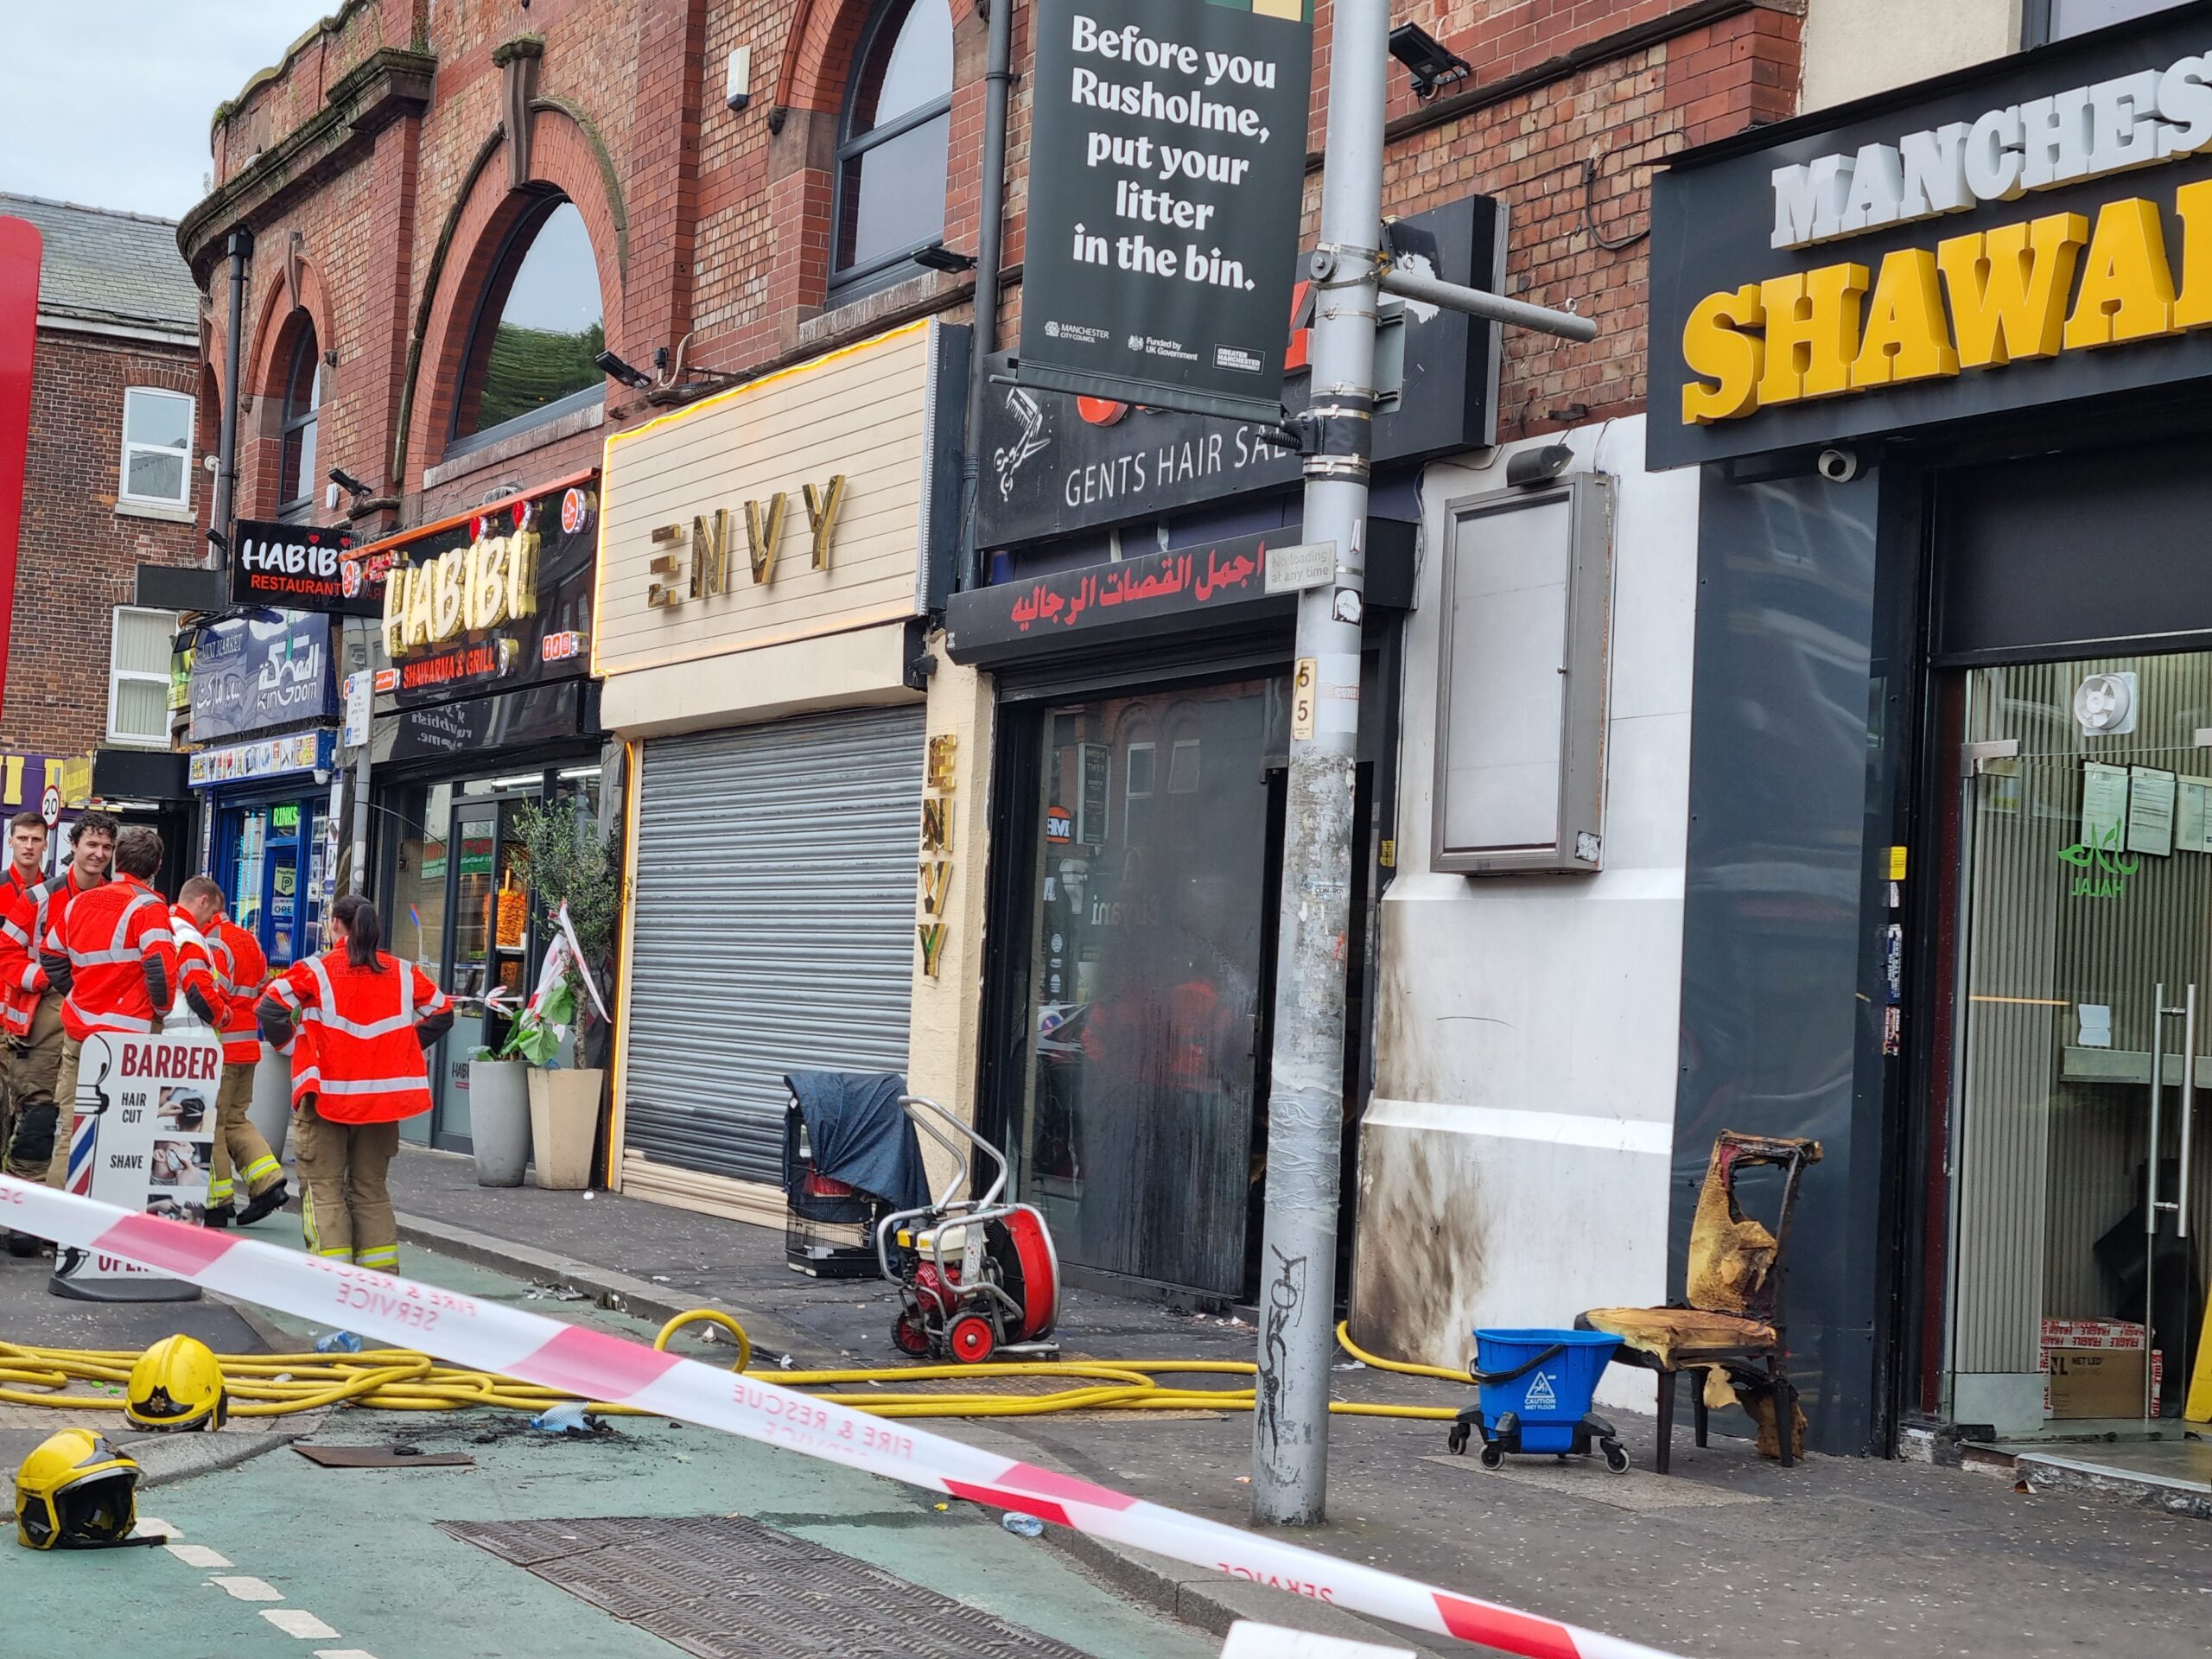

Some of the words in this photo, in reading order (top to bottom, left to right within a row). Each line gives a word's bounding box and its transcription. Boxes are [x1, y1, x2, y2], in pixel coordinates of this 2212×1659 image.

[1072, 15, 1198, 74] Before
[1205, 52, 1276, 89] you
[1071, 67, 1270, 143] Rusholme,
[1087, 132, 1153, 168] put
[1159, 145, 1249, 185] your
[1116, 180, 1215, 231] litter
[1073, 222, 1109, 265] in
[1116, 235, 1177, 276] the
[1185, 245, 1255, 291] bin.
[1061, 323, 1109, 339] MANCHESTER
[1072, 334, 1096, 343] COUNCIL
[1145, 346, 1157, 354] UK
[1157, 346, 1198, 361] Government
[1146, 337, 1172, 349] Funded
[1173, 340, 1182, 351] by
[1217, 348, 1248, 359] GREATER
[1217, 355, 1262, 366] MANCHESTER
[1065, 452, 1146, 506] GENTS
[1157, 433, 1222, 486] HAIR
[1234, 424, 1287, 468] SAL
[648, 474, 845, 607] ENVY
[1272, 554, 1287, 568] No
[1289, 548, 1327, 567] loading
[1194, 539, 1265, 601] اجمل
[1271, 571, 1283, 582] at
[1285, 570, 1303, 582] any
[1306, 565, 1329, 577] time
[251, 574, 342, 597] RESTAURANT
[1098, 554, 1193, 607] القصات
[382, 529, 536, 658] HABIBI
[403, 654, 454, 689] SHAWARMA
[456, 652, 464, 677] &
[467, 647, 495, 676] GRILL
[44, 798, 57, 815] 20
[273, 806, 298, 827] RINKS
[917, 734, 957, 977] ENVY
[282, 876, 293, 891] P
[274, 905, 293, 914] OPE
[121, 1043, 217, 1080] BARBER
[451, 1061, 469, 1079] HABI
[121, 1092, 147, 1108] HAIR
[122, 1109, 143, 1123] CUT
[110, 1154, 143, 1170] SHAVE
[2073, 1337, 2102, 1347] FRAGILE
[2109, 1338, 2139, 1348] FRAGILE
